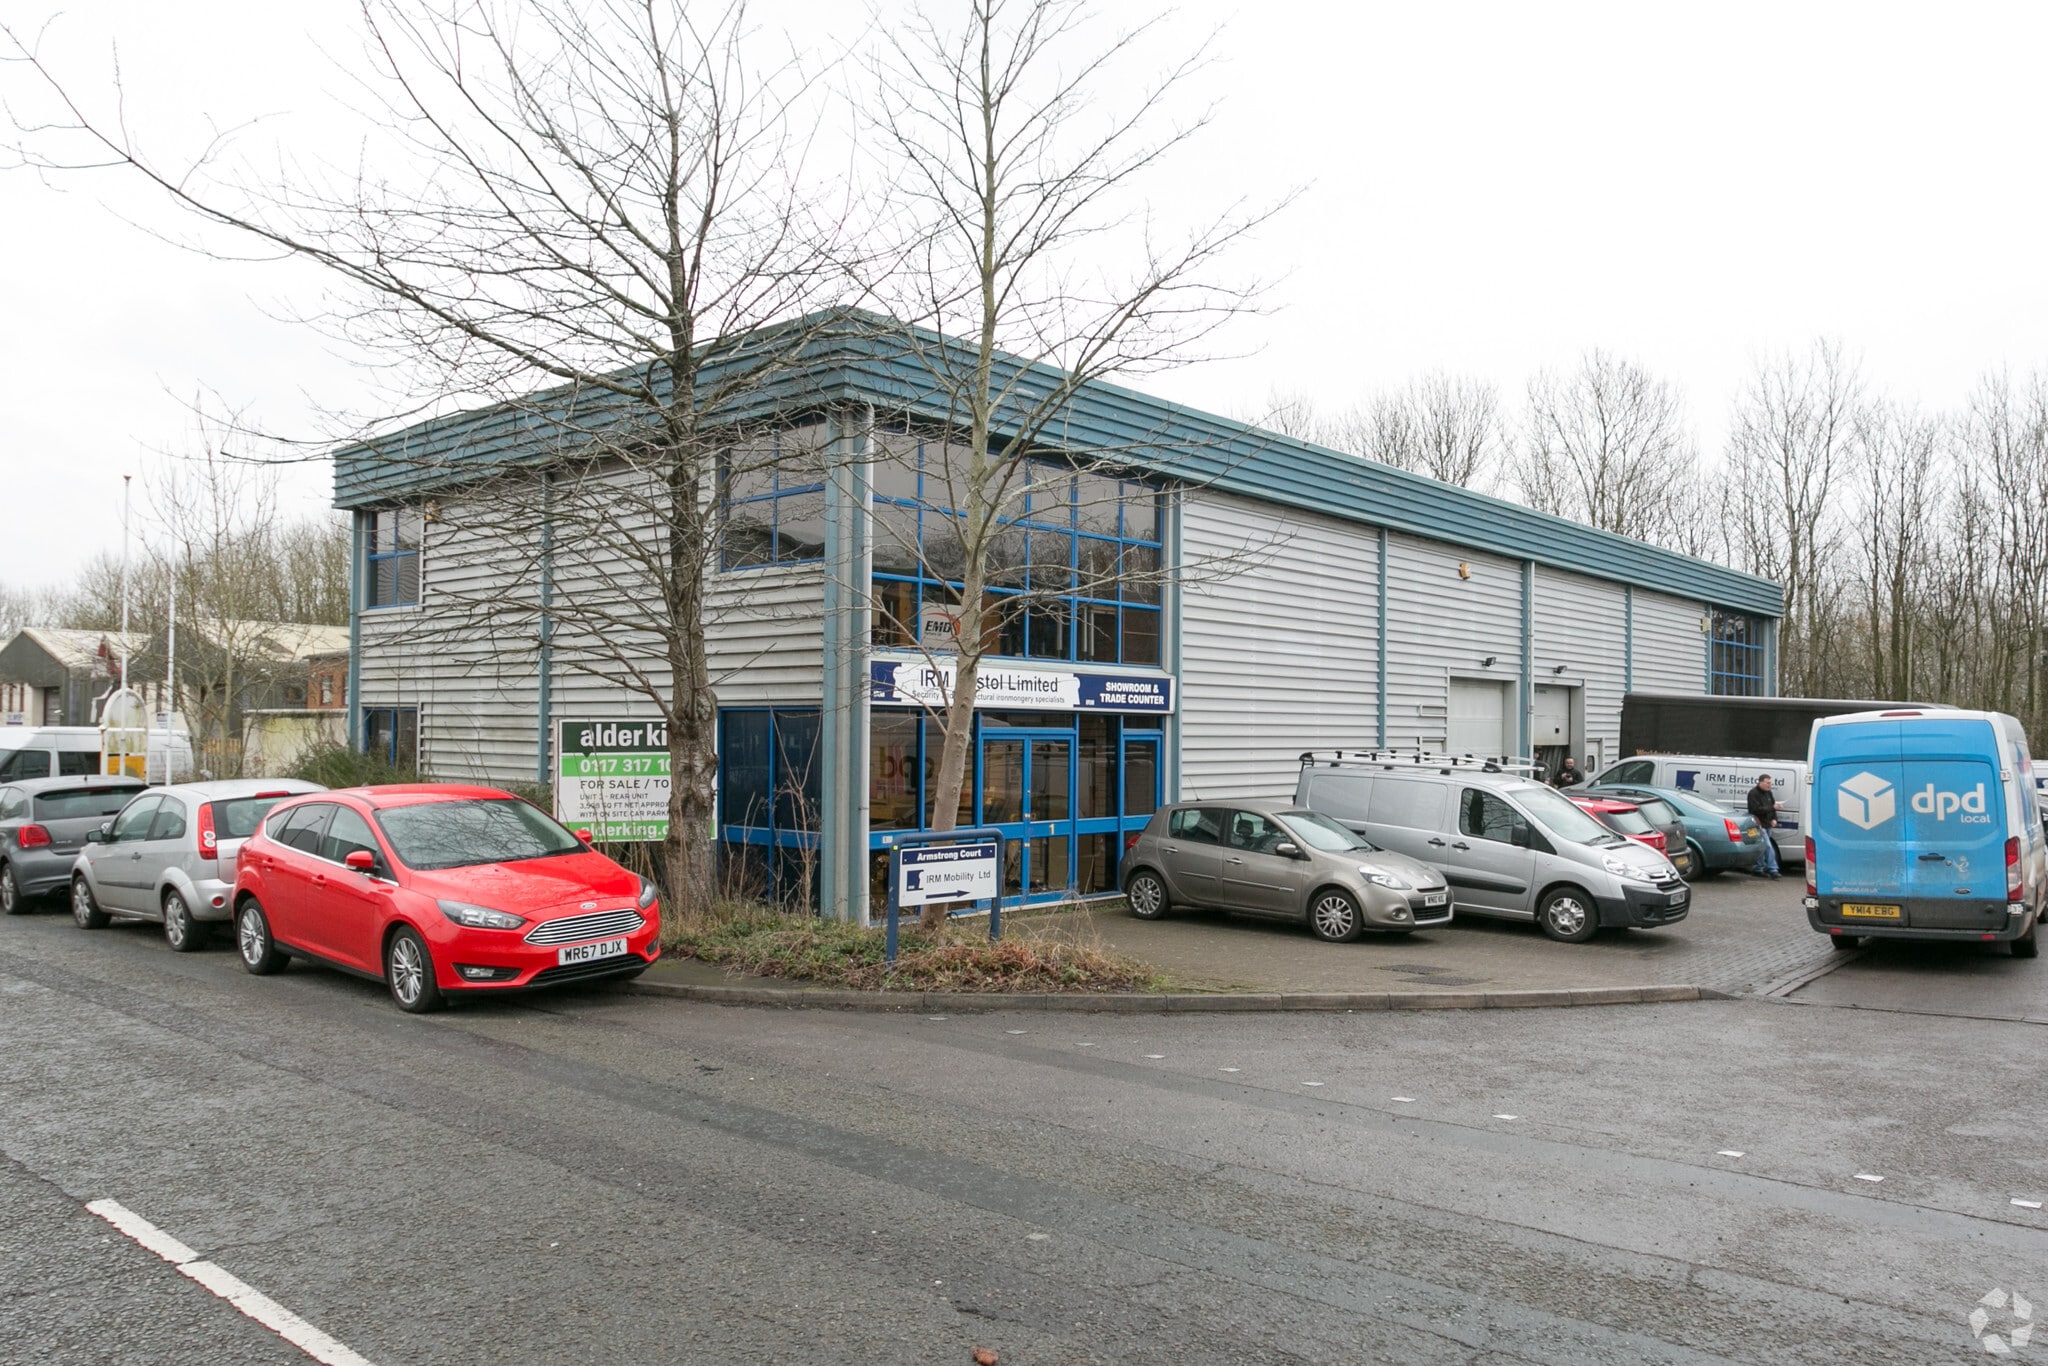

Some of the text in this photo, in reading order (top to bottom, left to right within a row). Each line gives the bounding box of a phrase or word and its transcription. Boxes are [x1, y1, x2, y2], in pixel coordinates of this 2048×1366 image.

[920, 669, 1058, 692] IRM stol Limited
[1105, 682, 1159, 694] SHOWROOM &
[912, 690, 939, 700] Security
[996, 694, 1034, 704] ironmongery
[1035, 695, 1065, 704] specialists
[1099, 693, 1127, 704] TRADE
[1127, 694, 1165, 705] COUNTER
[580, 723, 667, 747] alder ki
[580, 759, 618, 773] 0117
[622, 759, 652, 773] 317
[580, 780, 605, 790] FOR
[609, 780, 641, 789] SALE
[653, 779, 670, 789] TO
[1705, 773, 1785, 787] IRM Bristo td
[1911, 783, 1986, 821] dpd
[630, 810, 645, 818] CAR
[1960, 814, 1991, 823] local
[1049, 823, 1055, 835] 1
[917, 849, 982, 861] Armstrong Court
[926, 870, 991, 883] IRM Mobility Ltd
[1849, 906, 1895, 916] YM14 EBG
[564, 940, 623, 962] WR67 DJX
